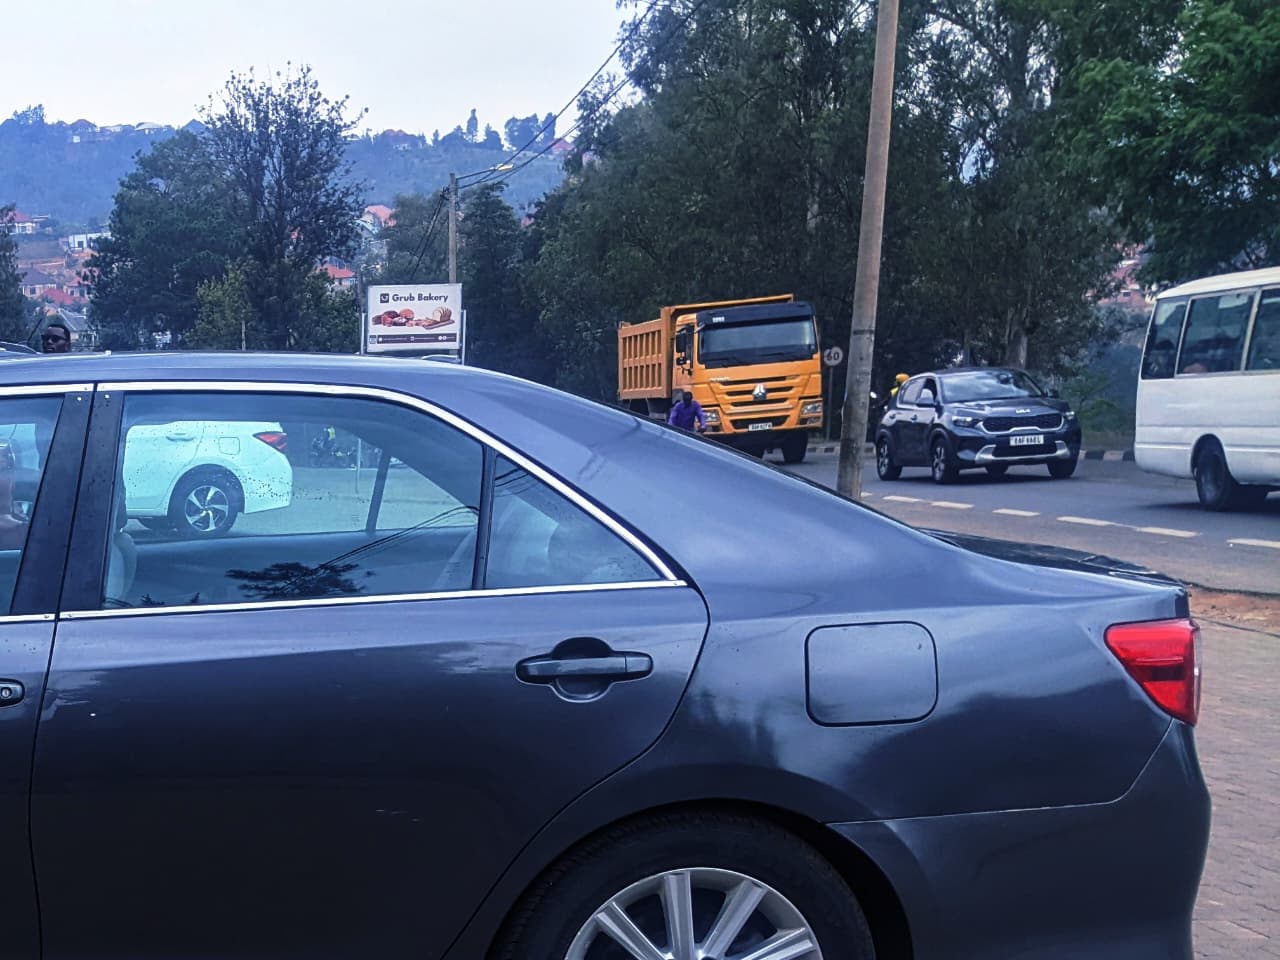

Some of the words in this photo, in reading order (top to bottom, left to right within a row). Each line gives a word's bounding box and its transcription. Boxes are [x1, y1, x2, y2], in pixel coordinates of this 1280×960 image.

[392, 292, 415, 302] Grub
[417, 292, 449, 303] Bakery
[825, 350, 840, 361] 60
